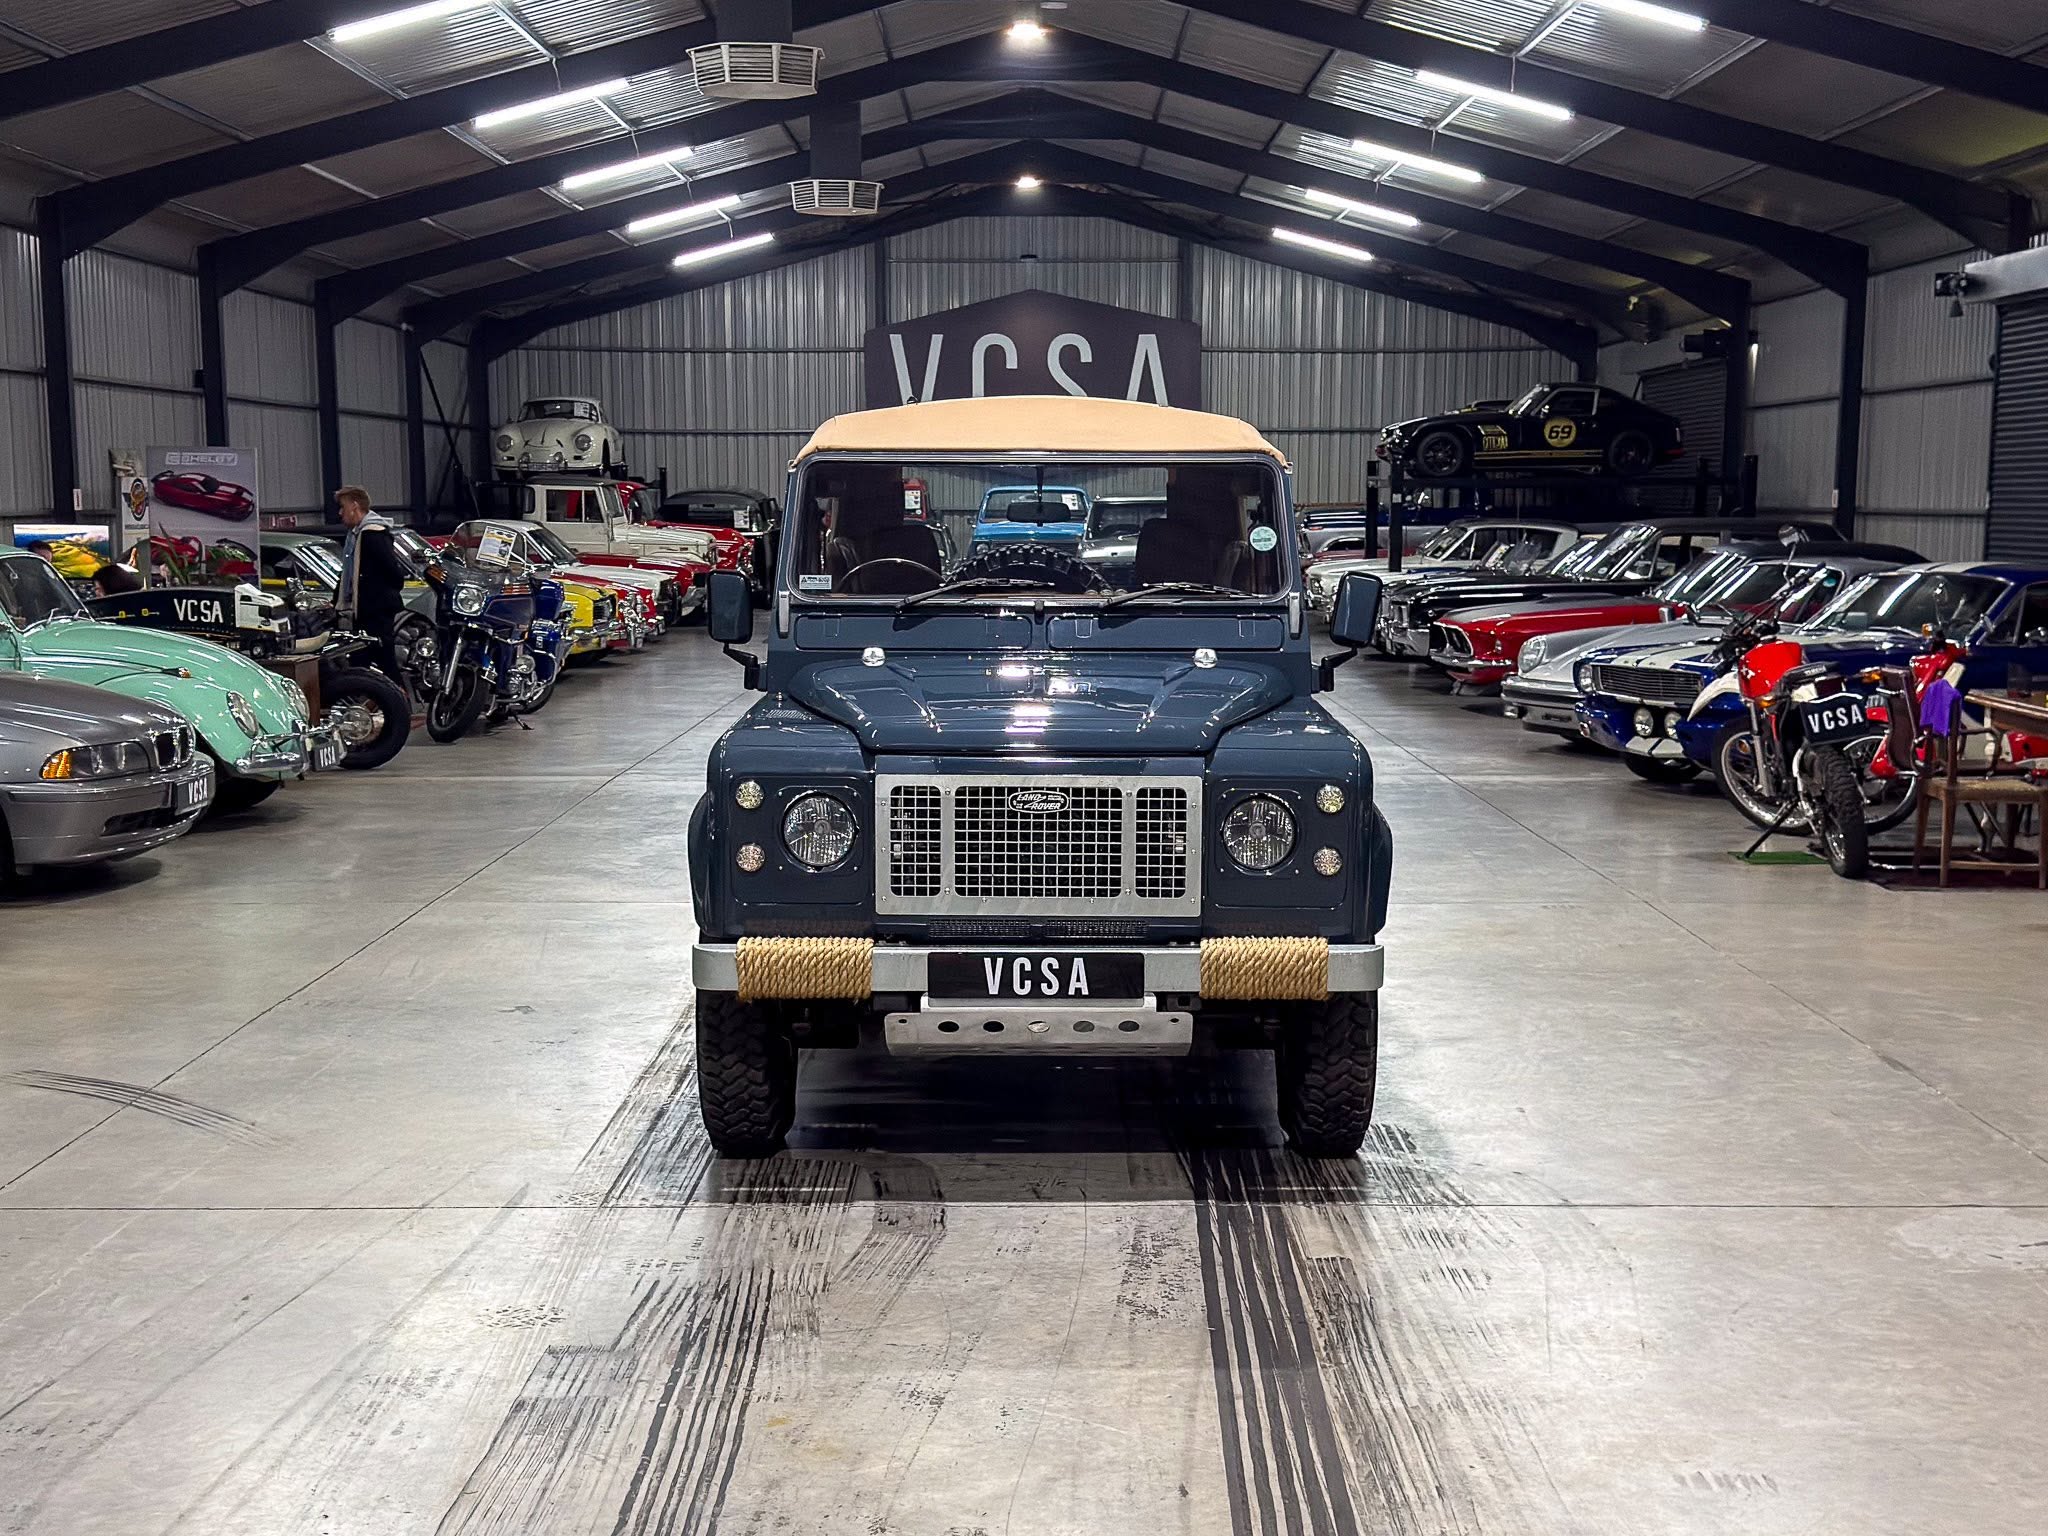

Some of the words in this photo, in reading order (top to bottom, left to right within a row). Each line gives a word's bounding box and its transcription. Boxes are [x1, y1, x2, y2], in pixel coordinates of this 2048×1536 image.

[889, 333, 1169, 407] VCSA
[1547, 425, 1572, 439] 69
[173, 598, 224, 623] VCSA
[1808, 704, 1864, 733] VCSA
[320, 745, 336, 767] VCSA
[188, 776, 208, 804] VCSA
[1016, 793, 1042, 801] LAND
[1030, 802, 1061, 810] ROVER
[983, 956, 1089, 996] VCSA
